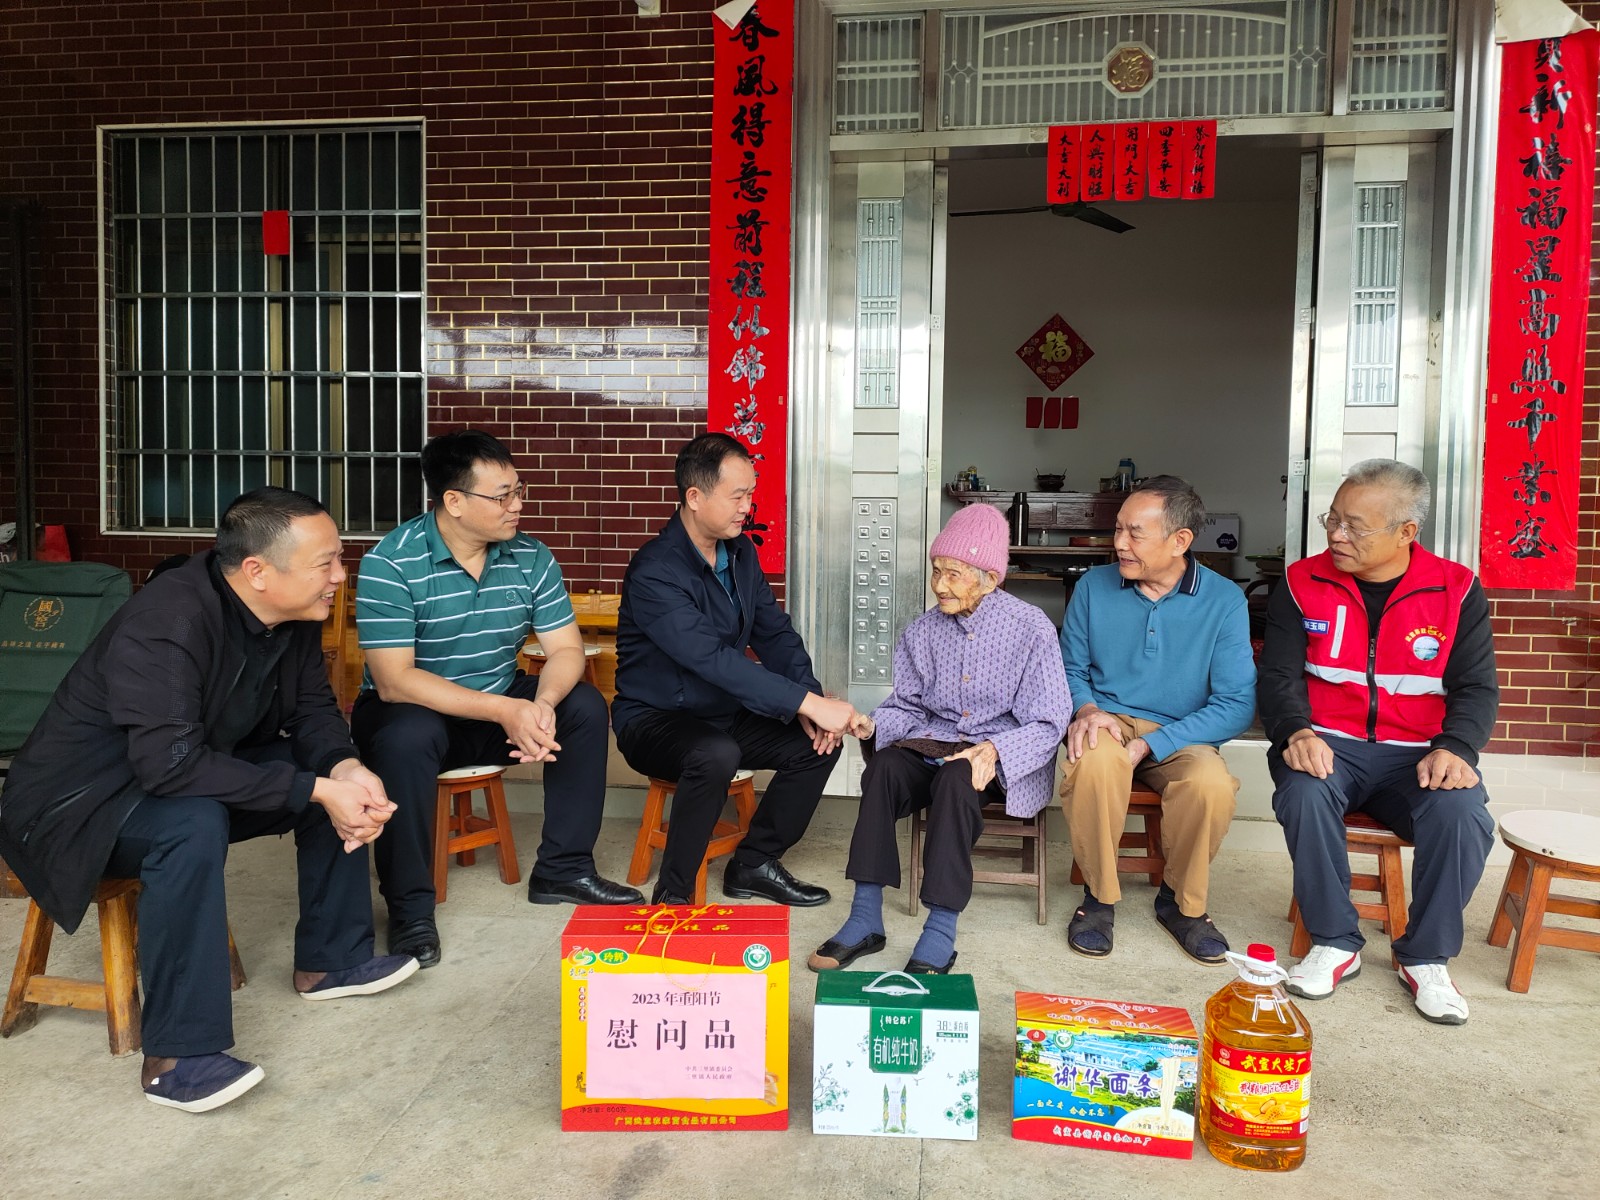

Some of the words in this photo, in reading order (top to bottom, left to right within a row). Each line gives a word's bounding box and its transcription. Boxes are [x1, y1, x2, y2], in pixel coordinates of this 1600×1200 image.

[1056, 131, 1073, 197] 大吉大利
[1157, 125, 1175, 193] 四季平安
[1039, 330, 1072, 363] 福
[607, 1018, 736, 1051] 慰问品
[873, 1035, 919, 1066] 有机纯牛奶
[1053, 1065, 1159, 1099] 谢华面条
